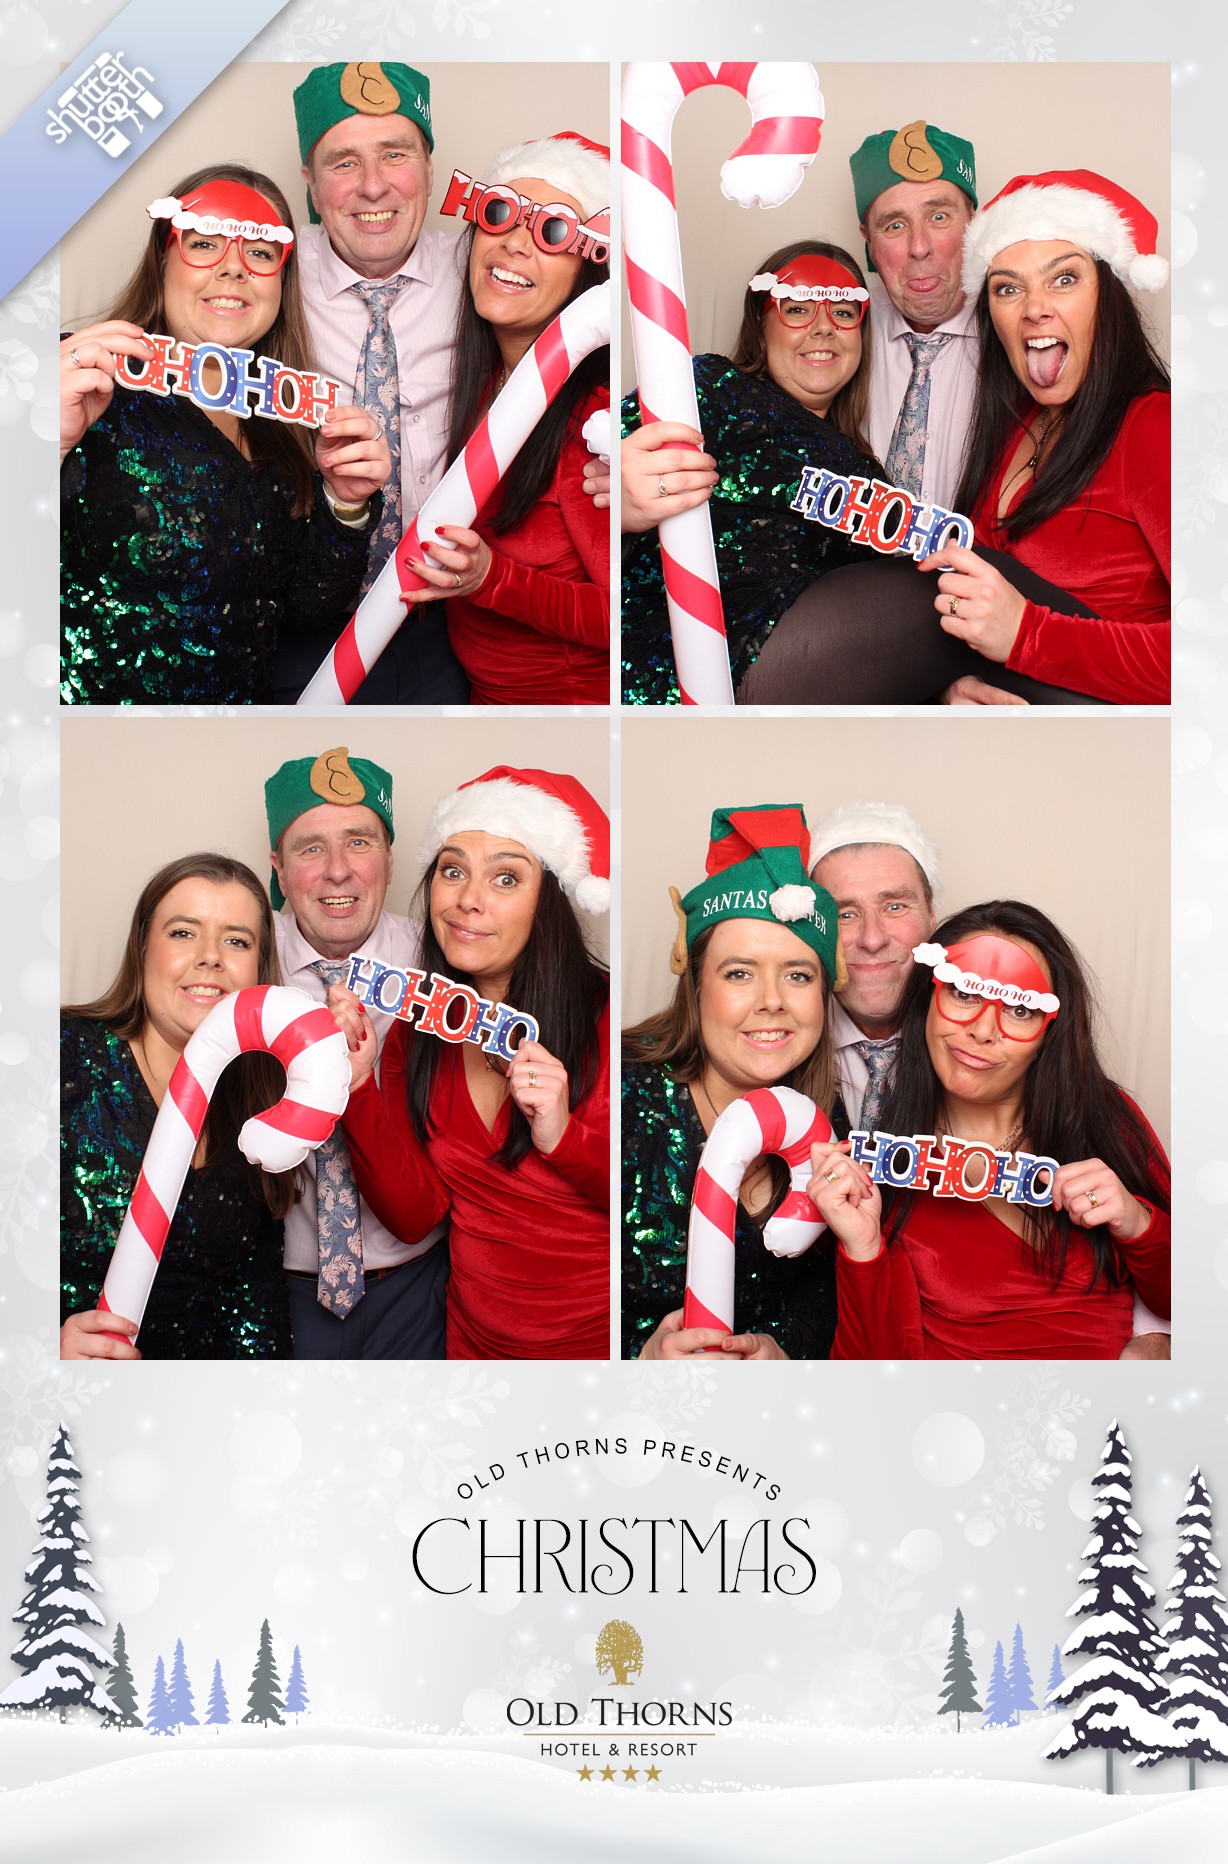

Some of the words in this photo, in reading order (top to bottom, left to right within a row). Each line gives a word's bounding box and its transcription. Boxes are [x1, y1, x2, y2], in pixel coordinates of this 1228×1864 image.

[226, 223, 247, 233] HO
[249, 225, 269, 236] HO
[702, 889, 768, 918] SANTAS
[963, 978, 985, 992] HO
[987, 985, 1009, 998] HO
[1010, 990, 1032, 1003] HO
